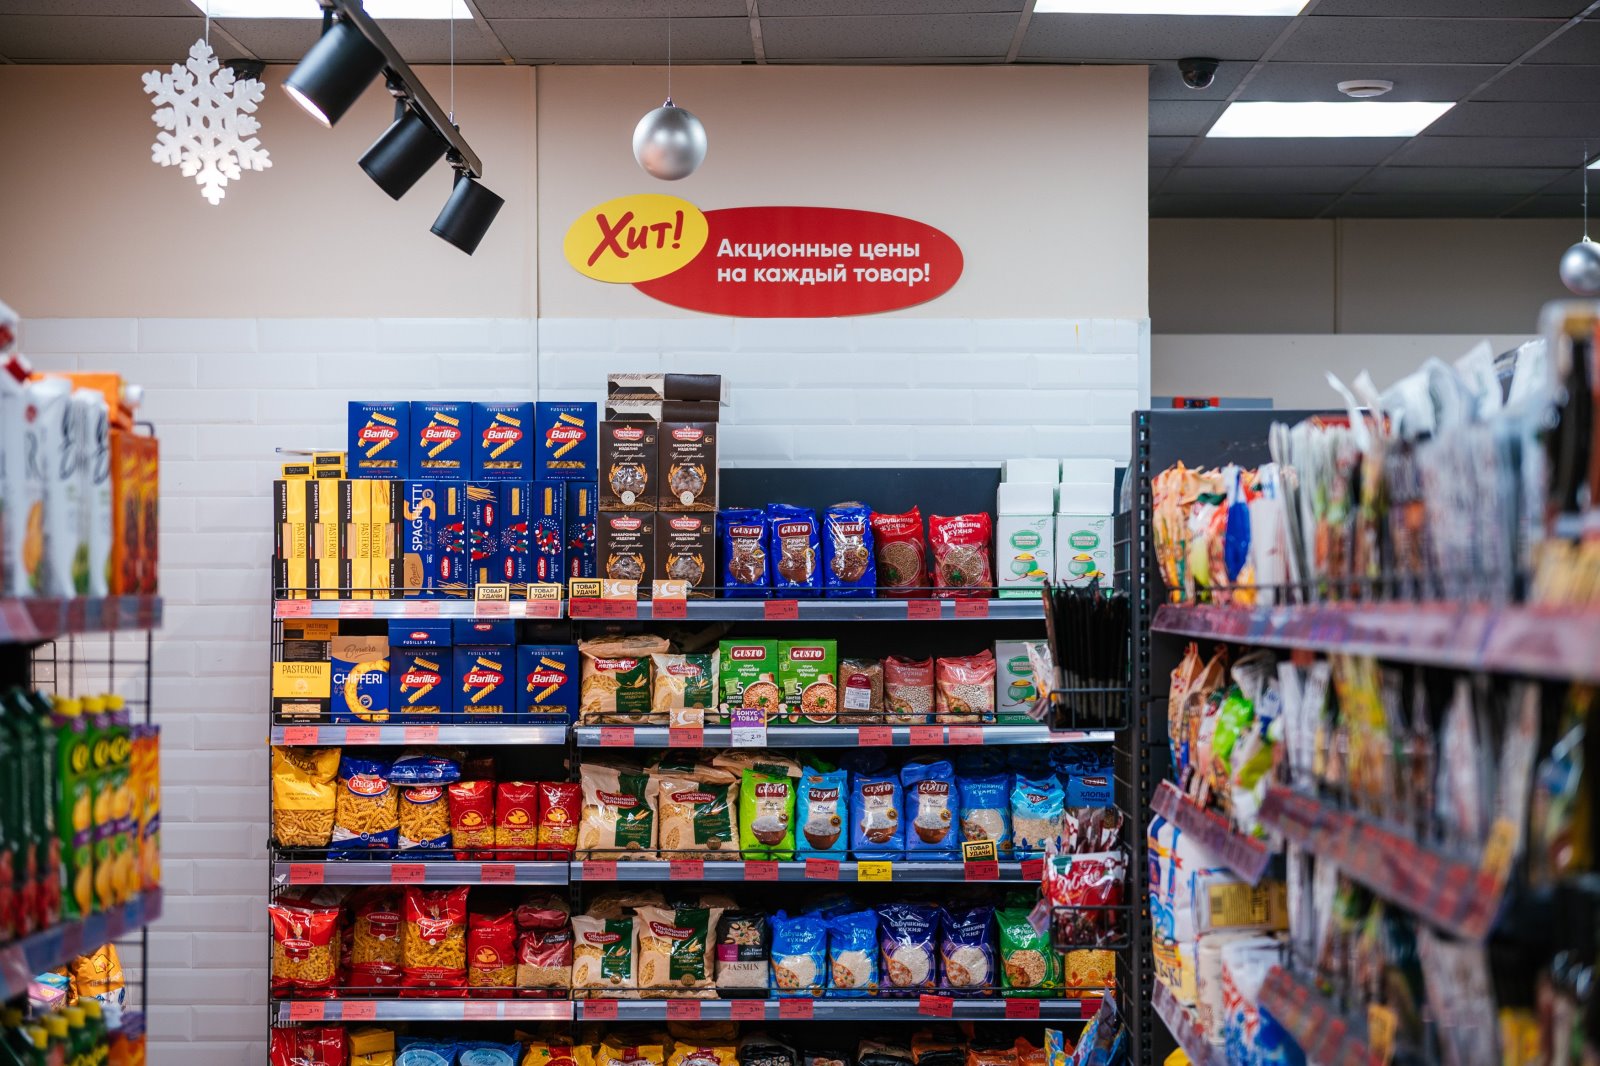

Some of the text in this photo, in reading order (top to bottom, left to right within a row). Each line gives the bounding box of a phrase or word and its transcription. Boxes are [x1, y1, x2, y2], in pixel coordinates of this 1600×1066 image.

[587, 210, 684, 267] Хит!
[717, 238, 920, 260] Акционные цены
[718, 263, 930, 286] на каждый товар!
[363, 429, 394, 438] Barilla
[426, 429, 456, 438] Barilla
[488, 430, 518, 439] Barilla
[551, 430, 582, 439] Barilla
[412, 484, 422, 551] SPAGHETTI
[781, 525, 808, 534] GUSTO
[296, 523, 304, 558] PASTERONI
[360, 523, 369, 558] PASTERONI
[282, 665, 321, 675] PASTERONI
[333, 673, 382, 684] CHIFFERI
[406, 674, 436, 683] Barilla
[469, 674, 499, 683] Barilla
[532, 674, 563, 683] Barilla
[737, 682, 744, 695] 5
[796, 683, 802, 695] 5
[865, 784, 891, 793] GUSTO
[653, 923, 693, 934] Столичная
[655, 929, 689, 938] мельница
